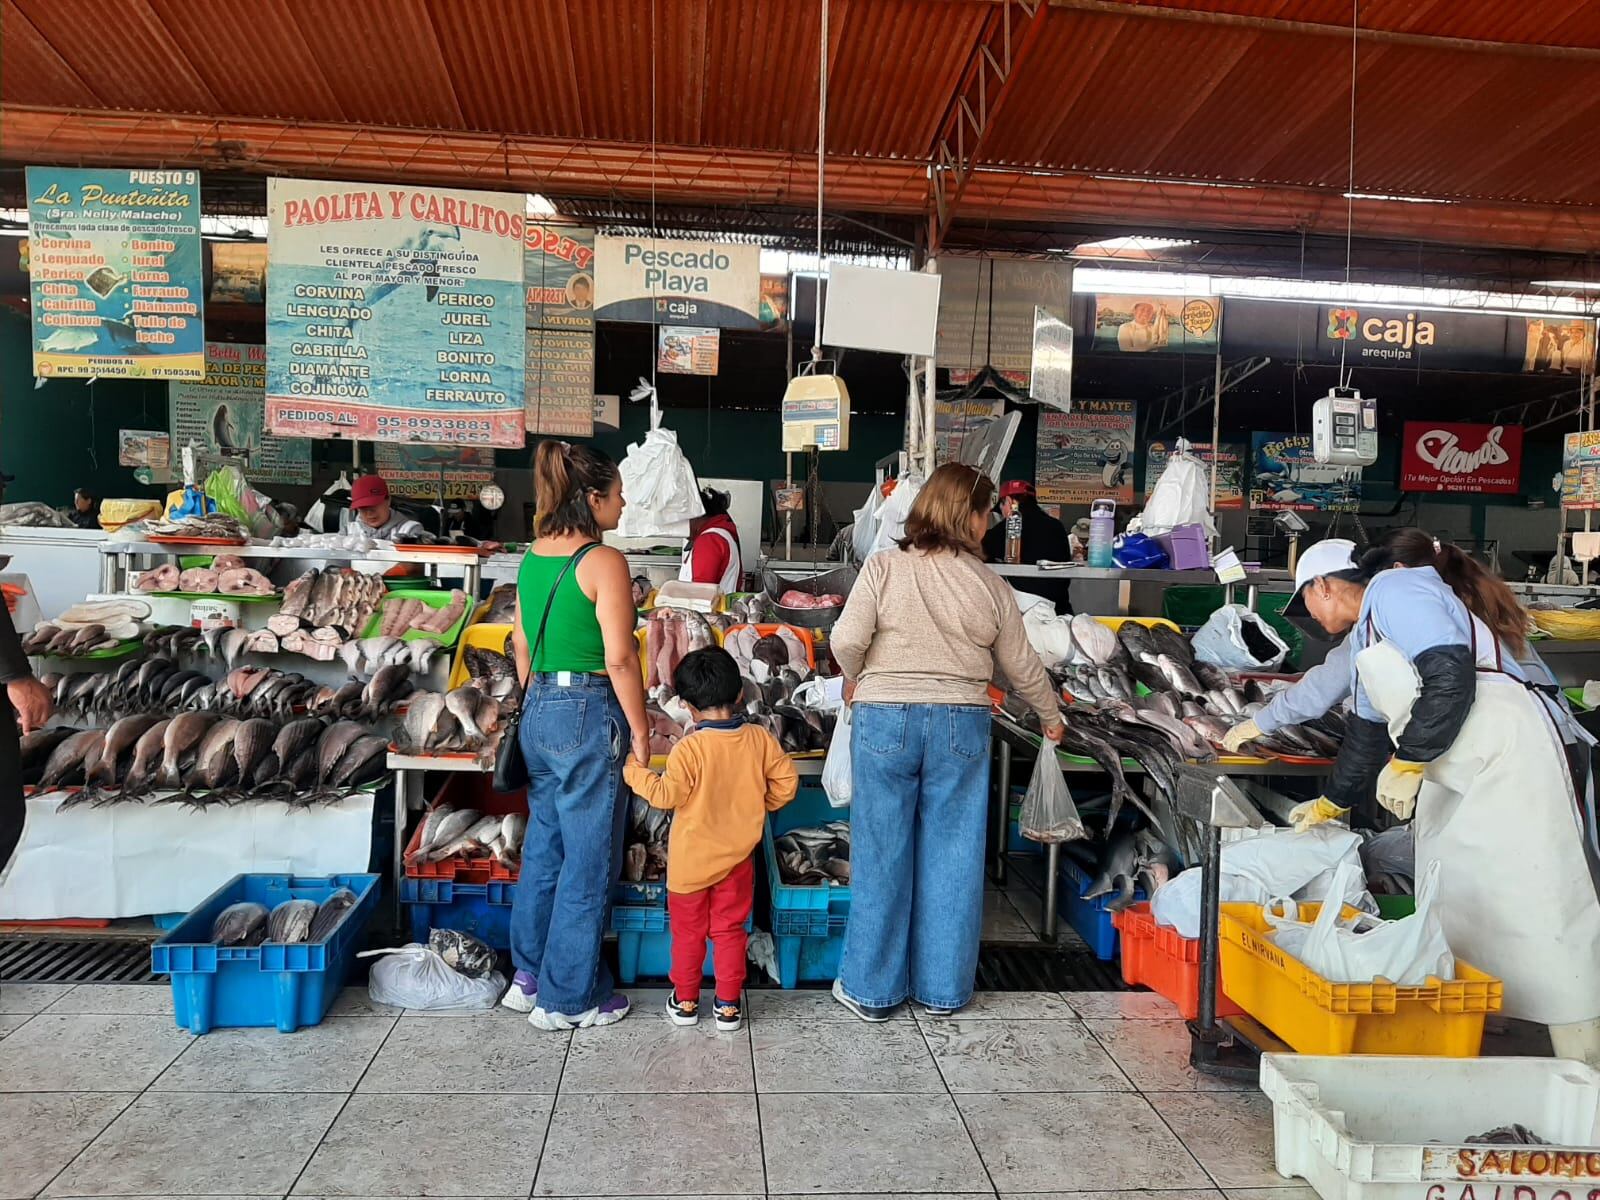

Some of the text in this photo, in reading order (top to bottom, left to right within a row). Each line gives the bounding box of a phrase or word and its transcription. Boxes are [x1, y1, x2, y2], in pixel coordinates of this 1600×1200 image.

[130, 172, 195, 185] PUESTO 9
[34, 184, 191, 207] La Punteñita
[46, 209, 77, 219] (Sra.
[83, 209, 117, 221] Nelly
[284, 191, 523, 240] PAOLITA Y CARLITOS
[34, 223, 76, 231] Ofrecemos
[98, 224, 119, 232] clase
[121, 224, 130, 232] de
[42, 238, 91, 249] Corvina
[132, 240, 174, 250] Bonito
[42, 253, 105, 265] Lenguado
[320, 246, 479, 262] LES OFRECE A SU DISTINGUIDA
[625, 244, 730, 270] Pescado
[42, 268, 84, 279] Perico
[325, 259, 476, 275] CLIENTELA PESCADO FRESCO
[132, 270, 168, 282] Lorna
[335, 272, 465, 287] AL POR MAYOR Y MENOR:
[645, 268, 708, 294] Playa
[43, 284, 77, 295] Chita
[295, 284, 365, 301] CORVINA
[43, 300, 95, 310] Cabrilla
[134, 301, 196, 313] Diamante
[438, 293, 495, 308] PERICO
[287, 303, 372, 320] LENGUADO
[669, 301, 697, 315] caja
[44, 314, 100, 325] Cojinova
[169, 317, 185, 328] de
[441, 313, 490, 327] JUREL
[137, 331, 174, 343] leche
[306, 325, 353, 338] CHITA
[1362, 312, 1435, 349] caja
[449, 332, 484, 346] LIZA
[291, 343, 368, 360] CABRILLA
[437, 351, 495, 365] BONITO
[1362, 347, 1411, 360] arequipa
[223, 363, 240, 373] DE
[289, 363, 369, 378] DIAMANTE
[440, 371, 492, 384] LORNA
[290, 382, 369, 398] COJINOVA
[425, 389, 506, 404] FERRAUTO
[1089, 401, 1132, 412] MAYTE
[279, 410, 358, 424] PEDIDOS AL:
[377, 416, 491, 431] 95-8933883
[1418, 474, 1438, 483] Mejor
[1467, 476, 1477, 484] En
[389, 484, 418, 494] DIDOS
